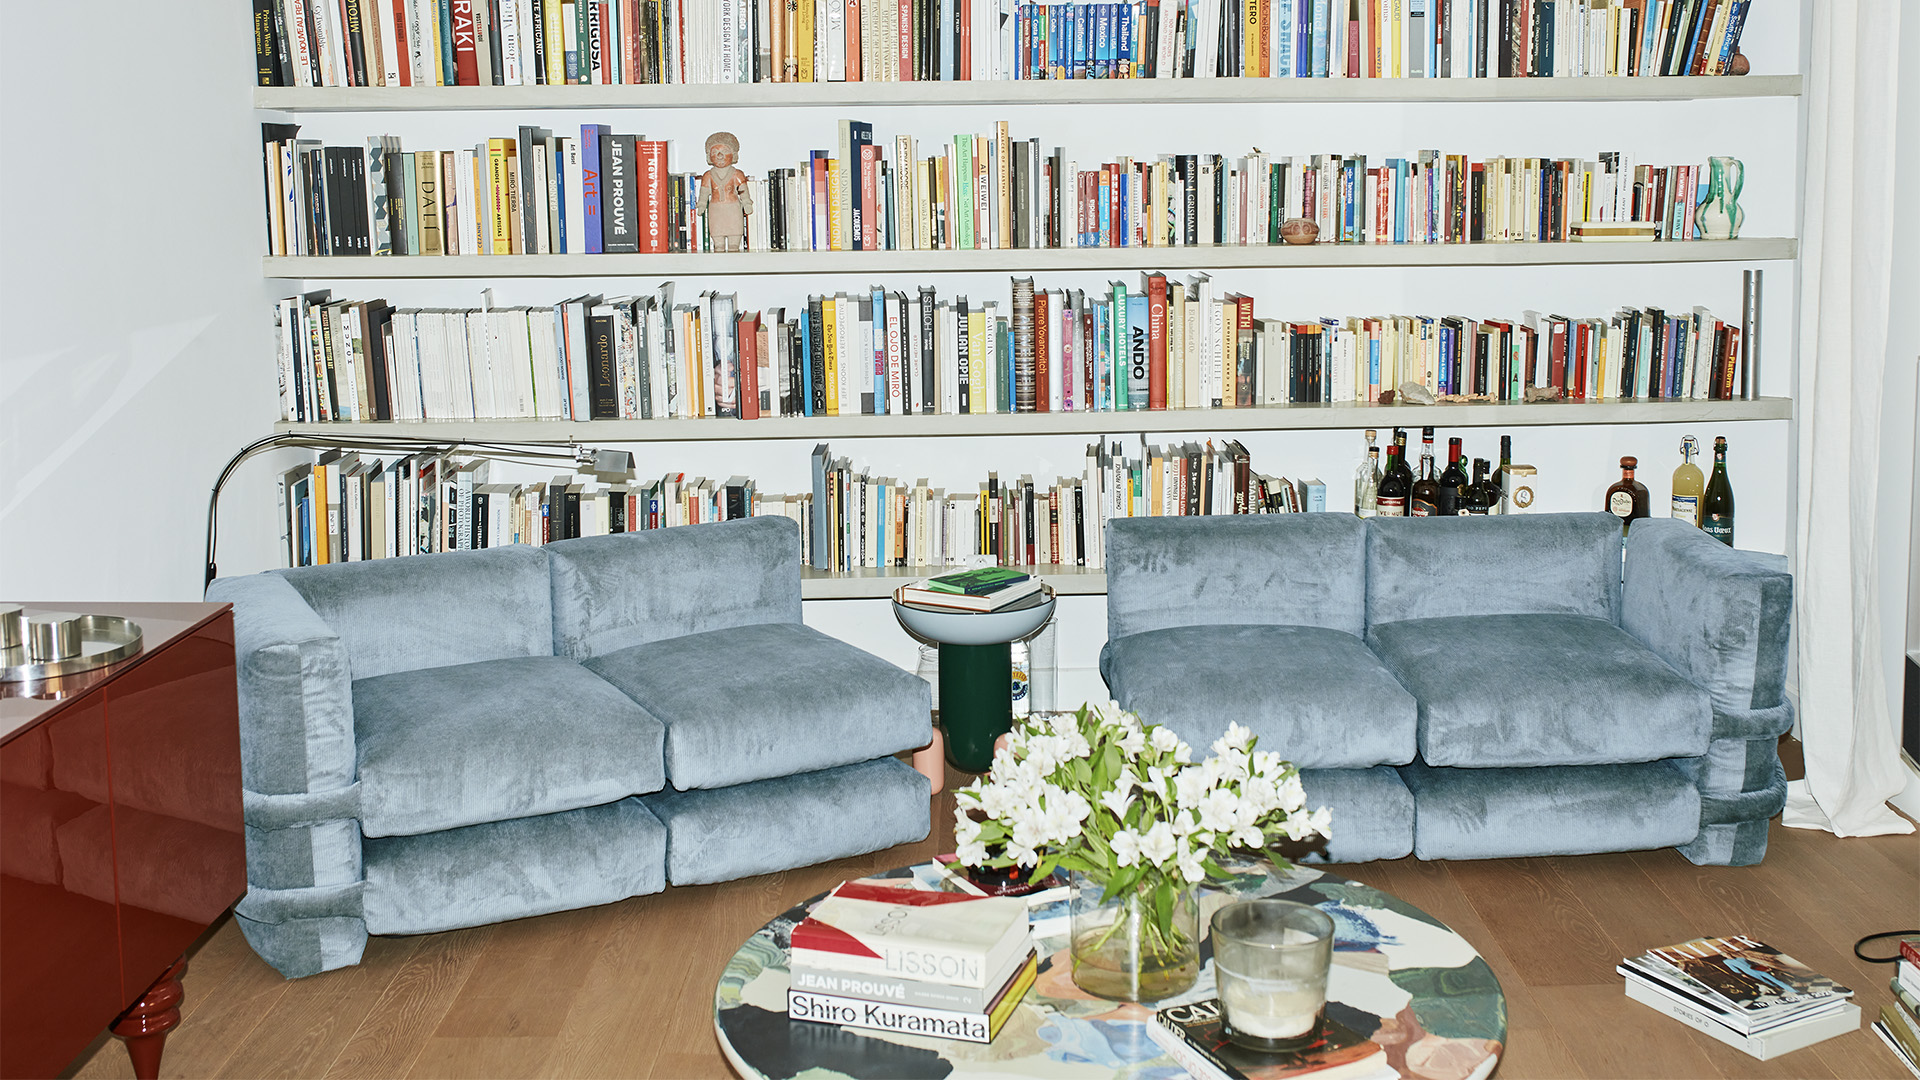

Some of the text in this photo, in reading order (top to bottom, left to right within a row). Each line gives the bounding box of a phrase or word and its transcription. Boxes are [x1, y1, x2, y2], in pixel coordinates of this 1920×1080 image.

[262, 10, 271, 32] Private
[453, 1, 474, 52] RAKI
[1249, 0, 1257, 24] TERO
[297, 17, 307, 54] NOUVEAU
[589, 2, 600, 71] RRIGOSA
[723, 19, 732, 42] DESIGN
[901, 5, 909, 59] SPANISH DESIGN
[1076, 18, 1085, 52] California
[1099, 18, 1107, 48] Mexico
[1121, 16, 1129, 51] Thailand
[1724, 15, 1737, 51] South Africa
[300, 56, 308, 66] LE
[723, 44, 731, 52] AT
[723, 54, 731, 73] HOME
[611, 139, 623, 177] JEAN
[648, 159, 657, 180] New
[961, 158, 970, 182] Happens
[584, 169, 599, 198] Art
[648, 183, 658, 206] York
[980, 164, 988, 211] AI WEIWEI
[1186, 160, 1195, 232] JOHN GRISHAM
[421, 181, 440, 231] DALÍ
[612, 179, 628, 235] PROUVÉ
[831, 169, 840, 247] INDIAN DESIGN
[649, 209, 658, 237] 1960
[853, 208, 861, 241] JACQUEMUS
[963, 219, 971, 246] Anthology
[924, 296, 933, 331] HOTELS
[1151, 303, 1164, 340] China
[1240, 303, 1250, 328] WITH
[814, 326, 822, 352] PREMIS
[1038, 300, 1046, 374] Pierre Yovanovitch
[1118, 294, 1127, 367] LUXURY HOTELS
[1214, 304, 1222, 381] EGON SCHIELE
[597, 334, 611, 387] Leonardo
[826, 344, 834, 356] York
[889, 317, 901, 398] EL OJO DE MIRÓ
[958, 313, 968, 385] JULIAN OPIE
[970, 332, 985, 394] Van Gogh
[1132, 326, 1144, 380] ANDO
[815, 354, 823, 385] ANUARIO
[828, 372, 836, 400] EXPLORER
[1725, 356, 1736, 388] Platform
[457, 488, 464, 498] OF
[885, 949, 979, 981] LISSON
[797, 973, 838, 991] JEAN
[841, 978, 906, 999] PROUVÉ
[792, 995, 986, 1039] Shiro Kuramata
[1673, 1006, 1695, 1022] STORIES
